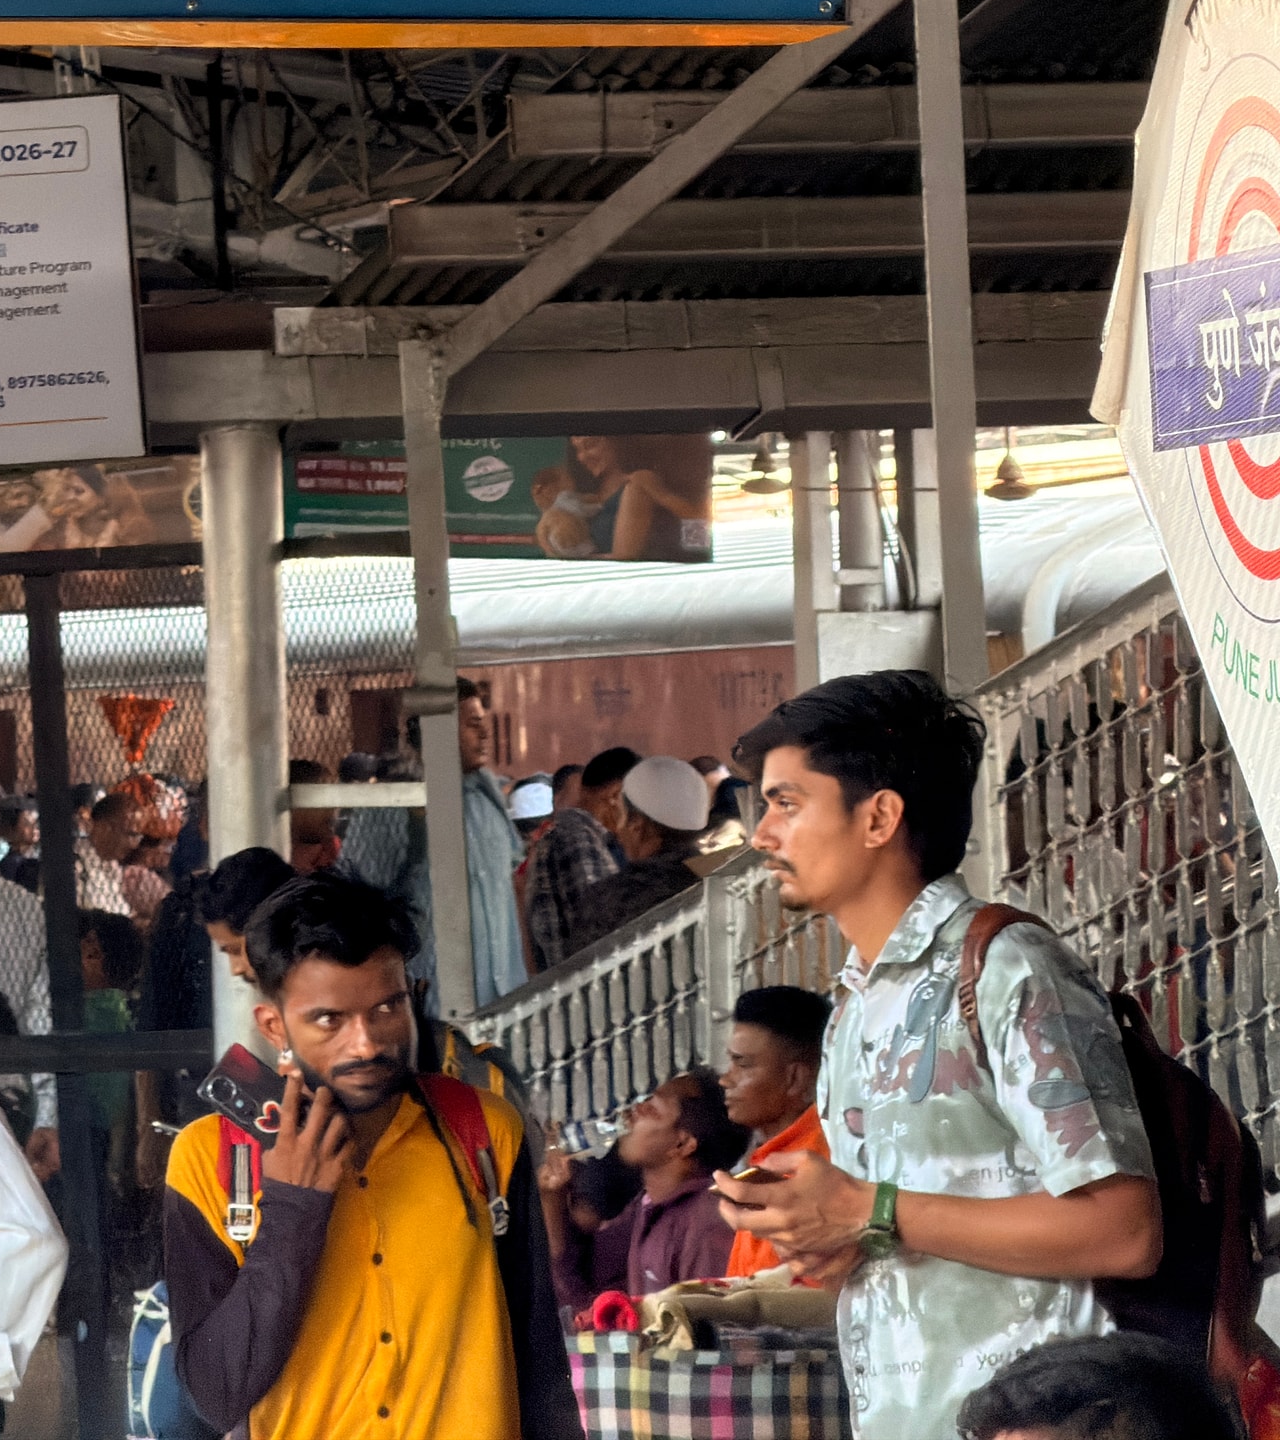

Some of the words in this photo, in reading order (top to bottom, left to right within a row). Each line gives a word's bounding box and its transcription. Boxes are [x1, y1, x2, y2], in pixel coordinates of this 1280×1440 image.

[29, 260, 92, 277] Program
[1198, 287, 1241, 410] पुणे
[1210, 611, 1260, 699] PUNE
